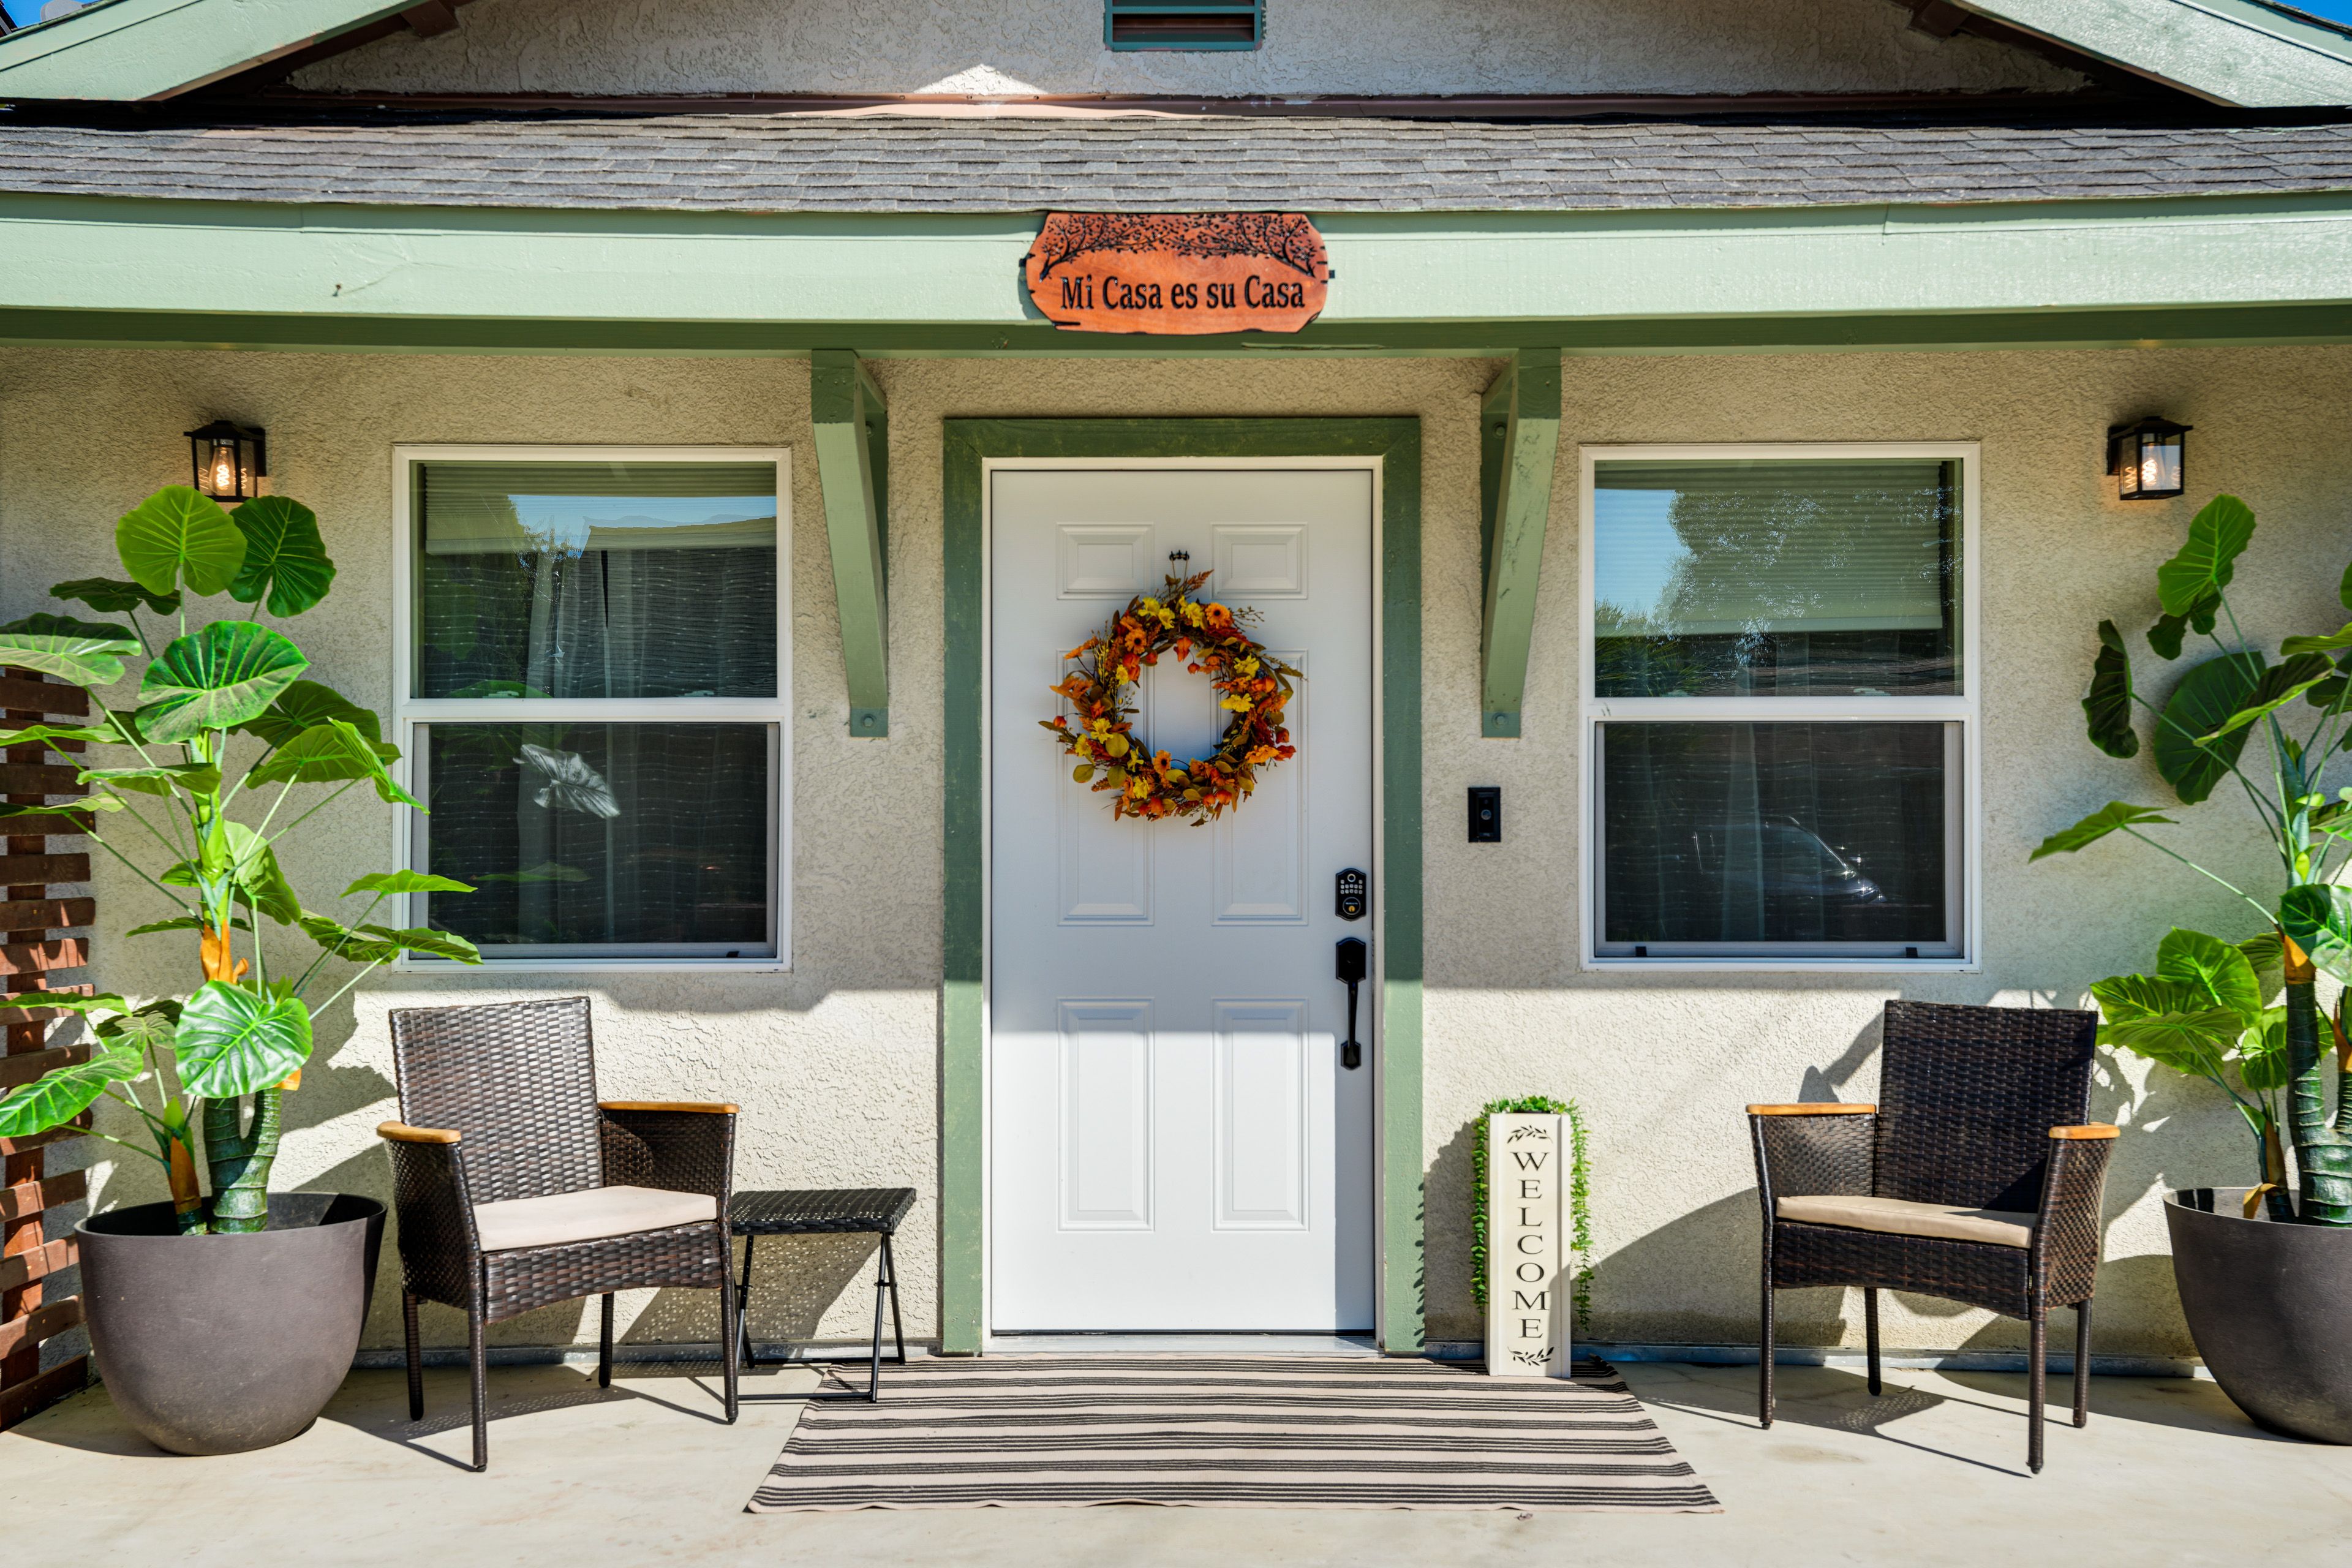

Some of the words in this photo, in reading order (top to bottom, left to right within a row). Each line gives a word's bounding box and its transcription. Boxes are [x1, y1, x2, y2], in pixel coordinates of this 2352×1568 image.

[1060, 274, 1095, 309] Mi
[1102, 275, 1163, 309] Casa
[1170, 282, 1197, 309] es
[1207, 282, 1236, 309] su
[1244, 274, 1305, 309] Casa
[1510, 1152, 1550, 1339] WELCOME
